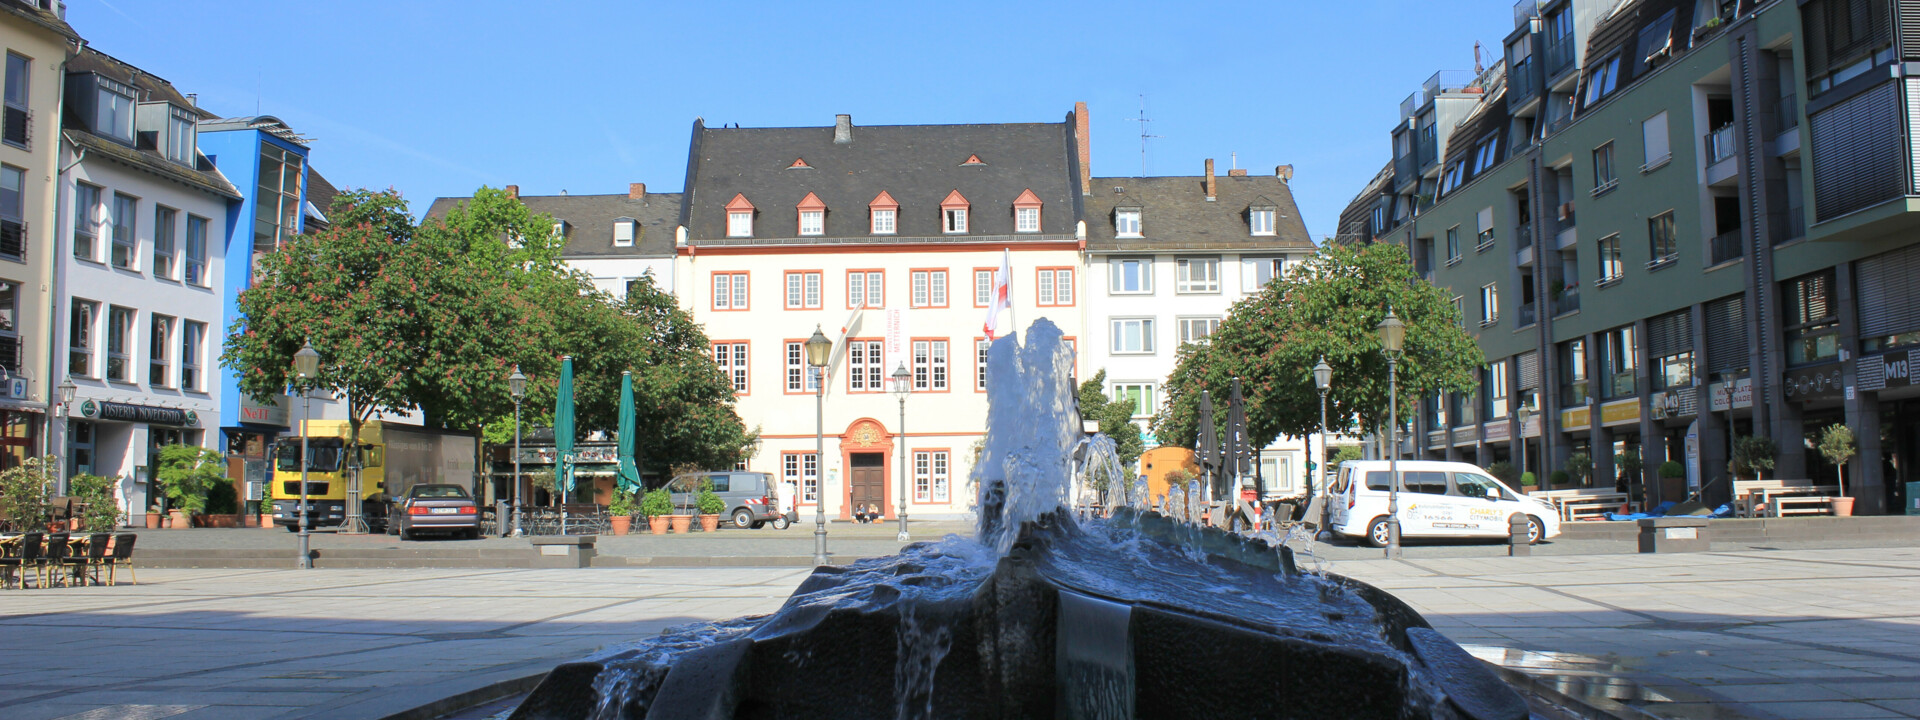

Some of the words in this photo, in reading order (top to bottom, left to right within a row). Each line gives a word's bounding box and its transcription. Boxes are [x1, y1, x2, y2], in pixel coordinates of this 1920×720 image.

[1884, 360, 1908, 380] M13
[1665, 394, 1678, 409] M13
[104, 404, 136, 417] OSTERIA
[139, 407, 180, 420] NOVECENTO
